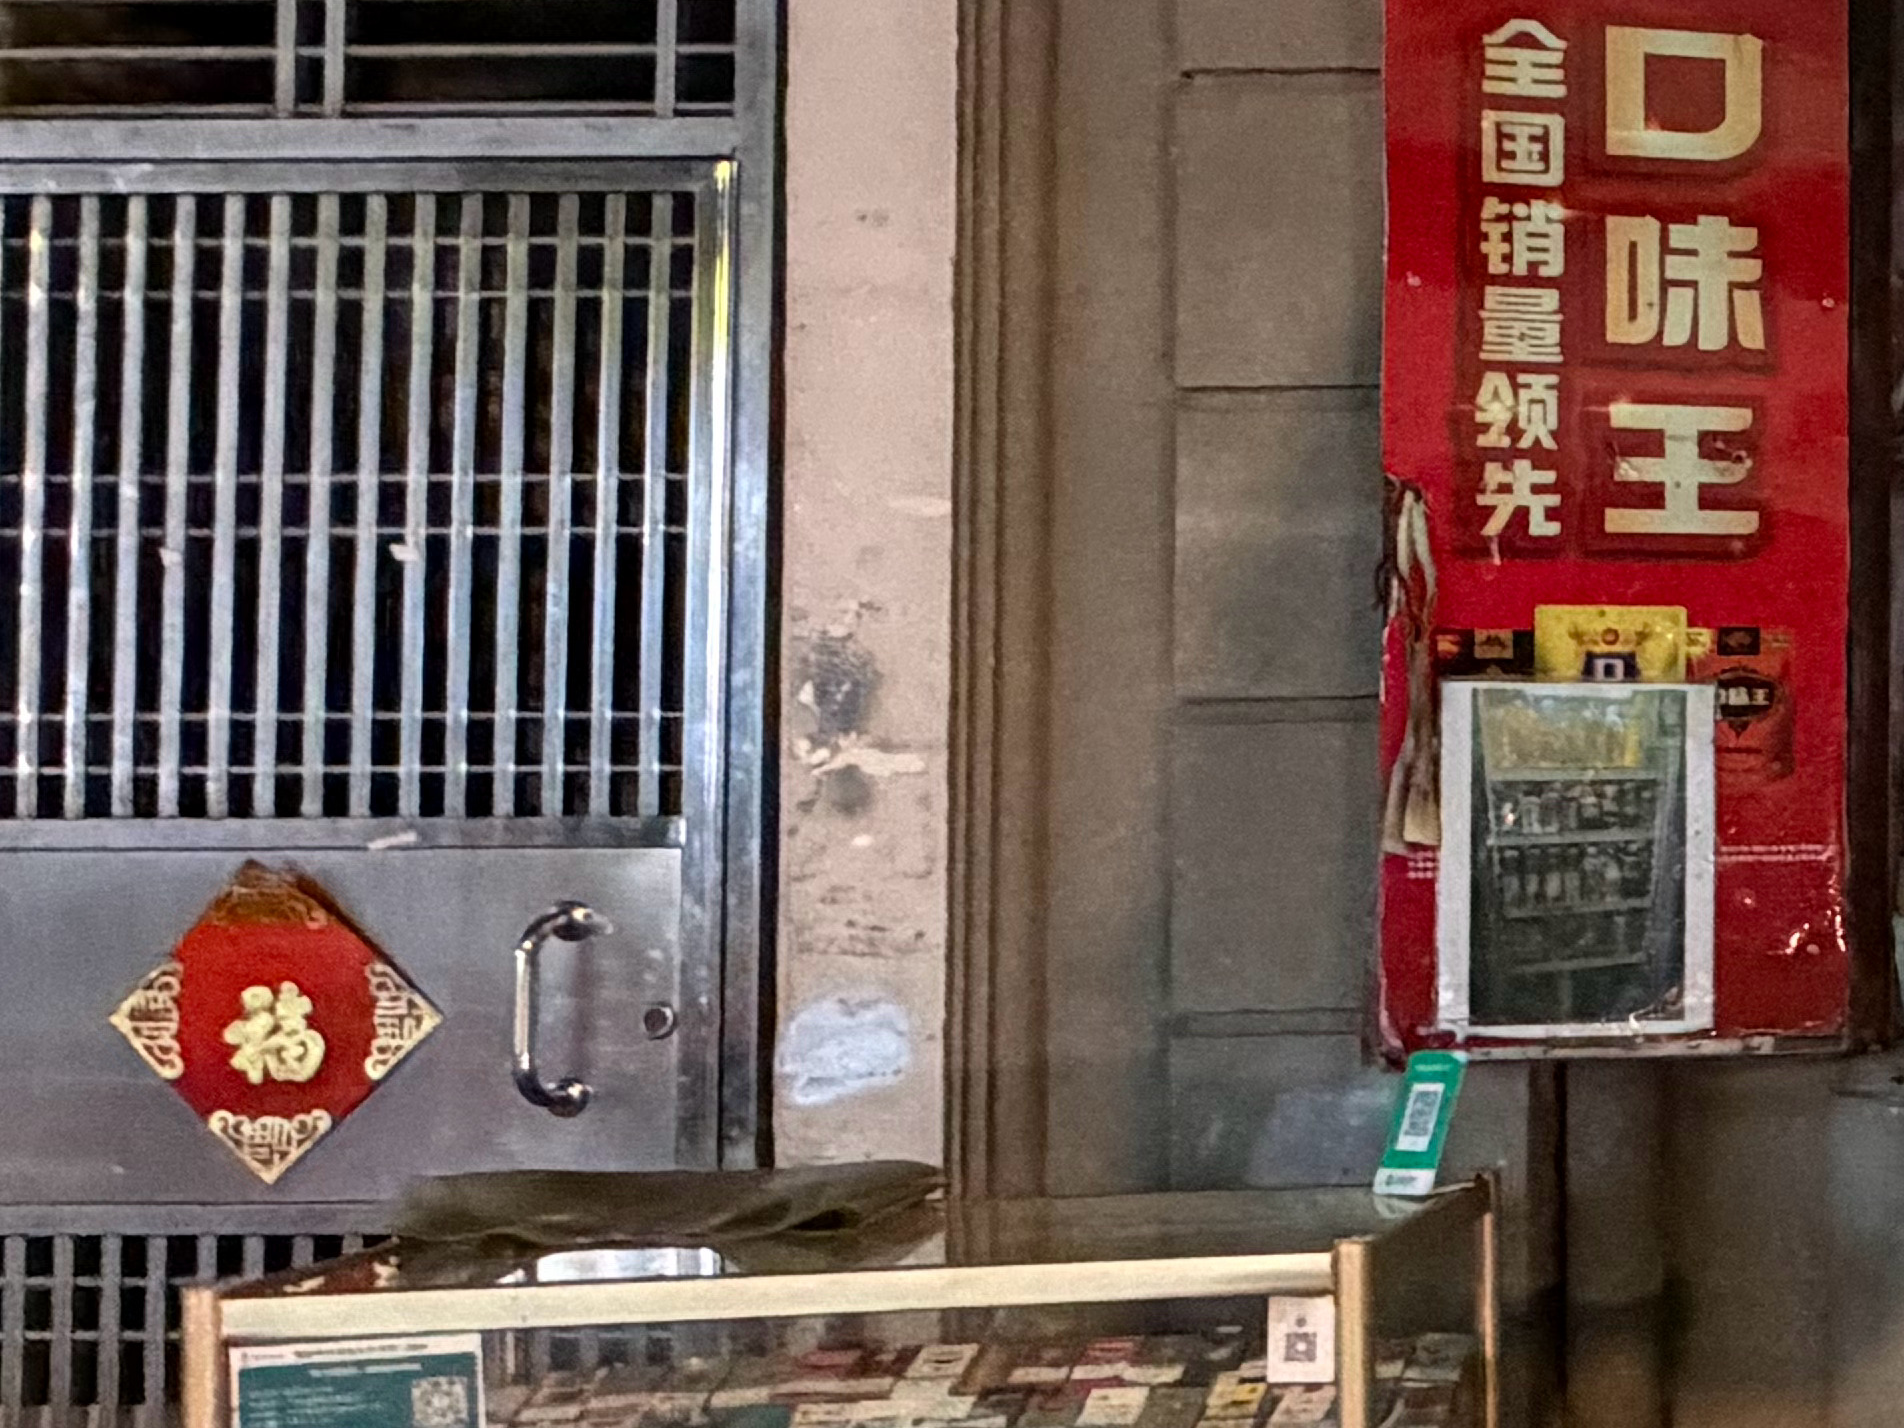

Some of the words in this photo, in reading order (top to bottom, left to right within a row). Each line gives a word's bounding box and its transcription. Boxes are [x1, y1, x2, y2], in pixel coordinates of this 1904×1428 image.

[1475, 18, 1568, 538] 全国销量领先
[1603, 24, 1766, 535] 口味王
[222, 980, 326, 1085] 福
